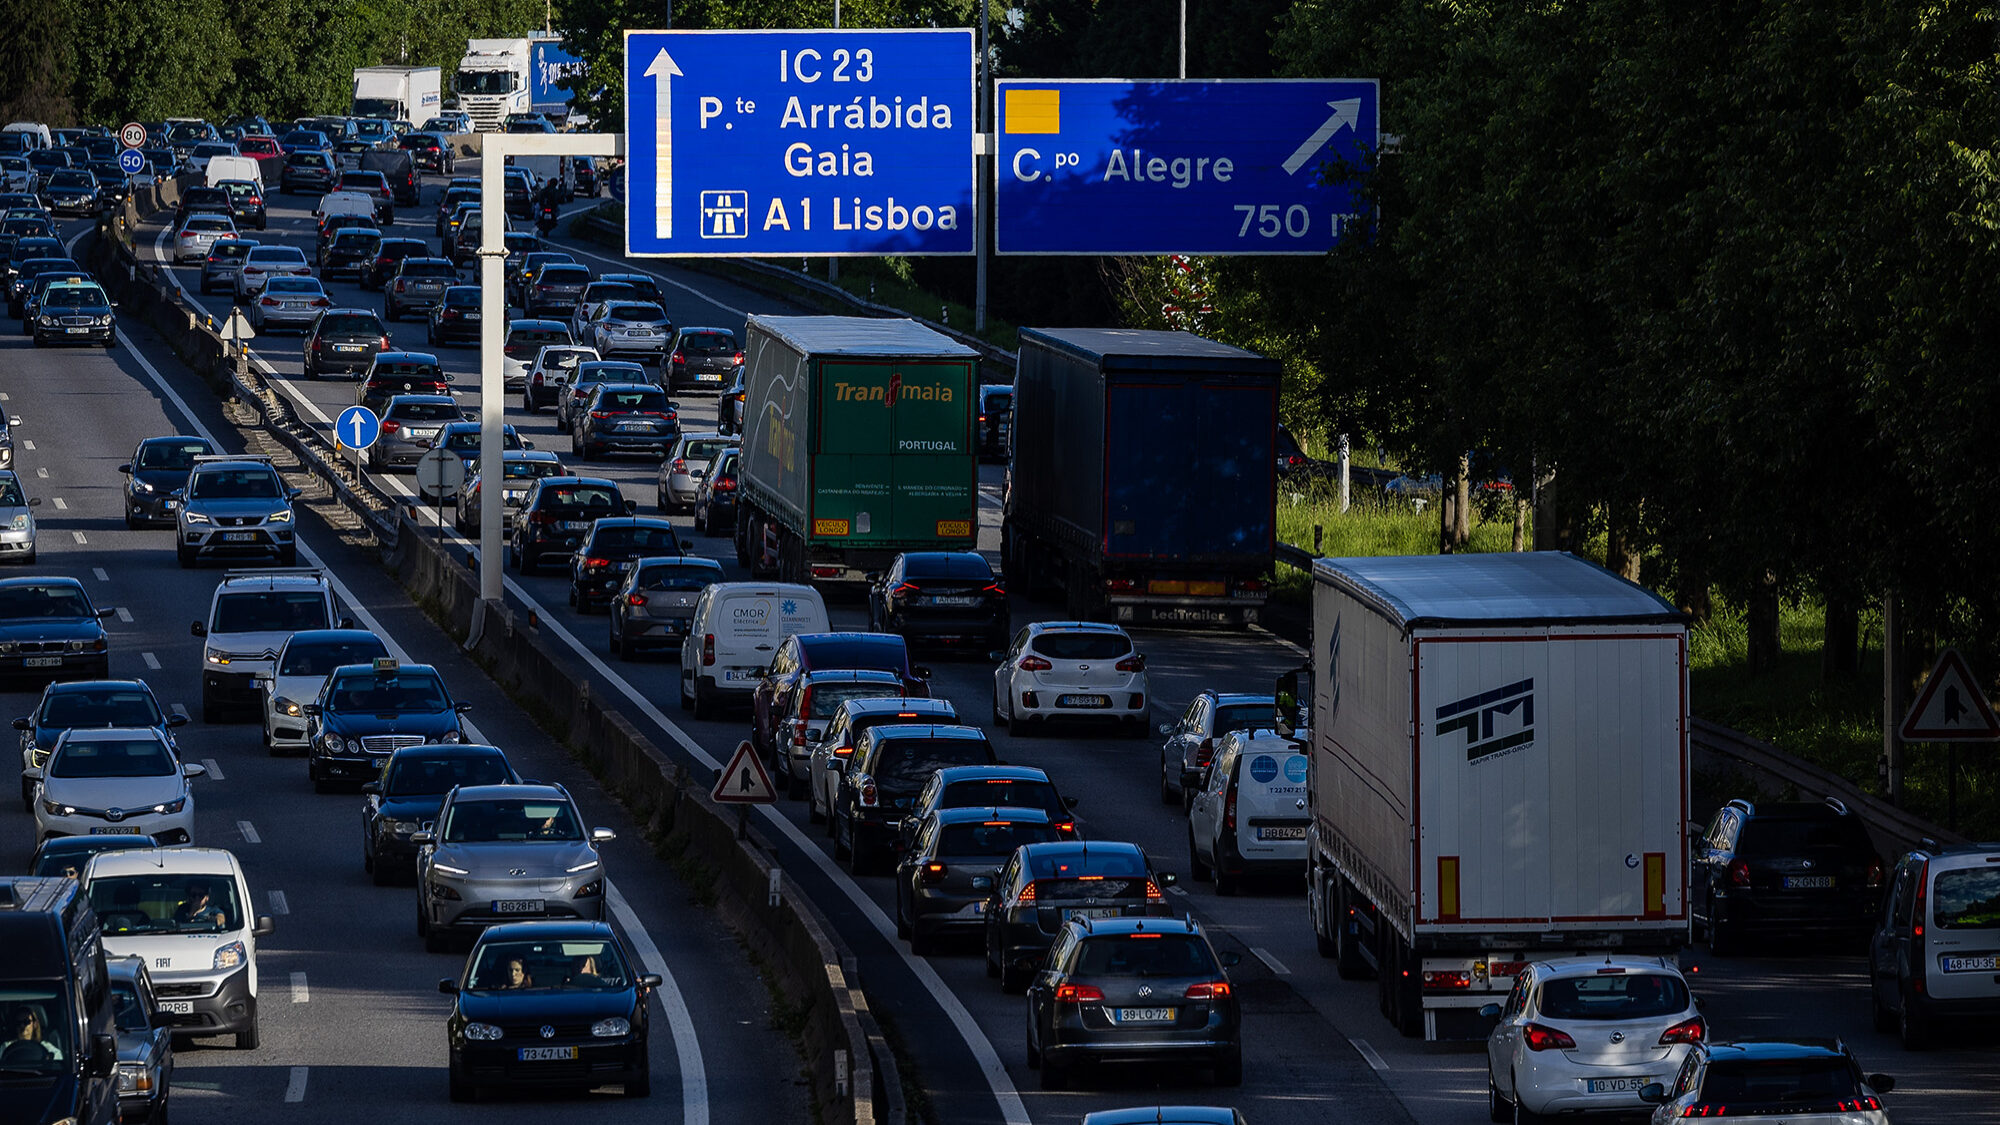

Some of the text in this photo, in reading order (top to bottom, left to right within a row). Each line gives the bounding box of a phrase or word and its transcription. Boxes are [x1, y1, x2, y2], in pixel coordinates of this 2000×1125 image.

[780, 48, 874, 83] IC 23
[780, 95, 952, 130] Arrábida
[126, 130, 142, 140] 80
[123, 156, 140, 168] 50
[784, 142, 874, 178] Gaia
[1104, 148, 1234, 189] Alegre
[833, 196, 958, 231] Lisboa
[1234, 204, 1310, 238] 750
[899, 440, 957, 450] PORTUGAL
[733, 608, 764, 618] CMOR
[1151, 608, 1226, 621] LeciTrailer
[1470, 742, 1534, 766] MAPIR TRANS-GROUP
[156, 958, 171, 968] FIAT
